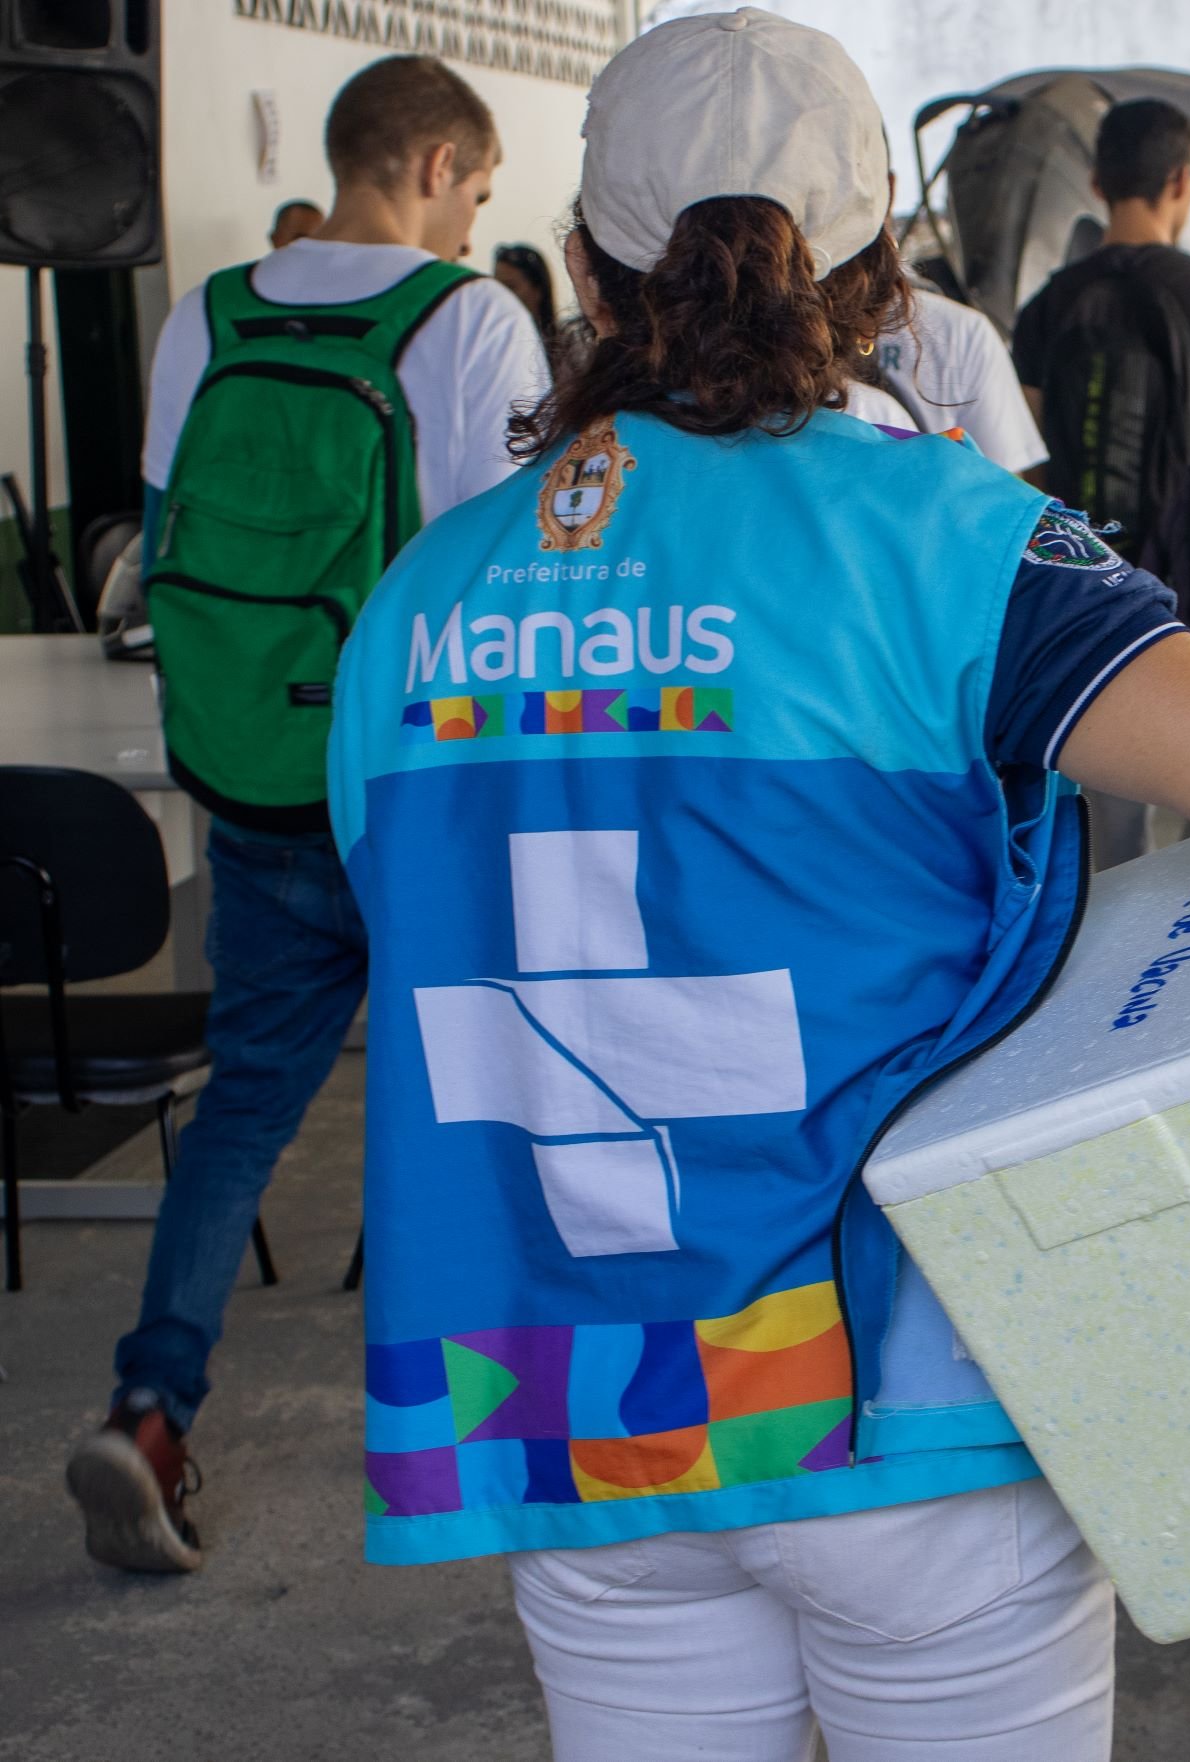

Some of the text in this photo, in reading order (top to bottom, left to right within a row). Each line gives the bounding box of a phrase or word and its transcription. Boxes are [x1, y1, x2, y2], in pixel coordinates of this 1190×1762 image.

[486, 557, 647, 584] Prefeitura de
[405, 601, 737, 694] Manaus
